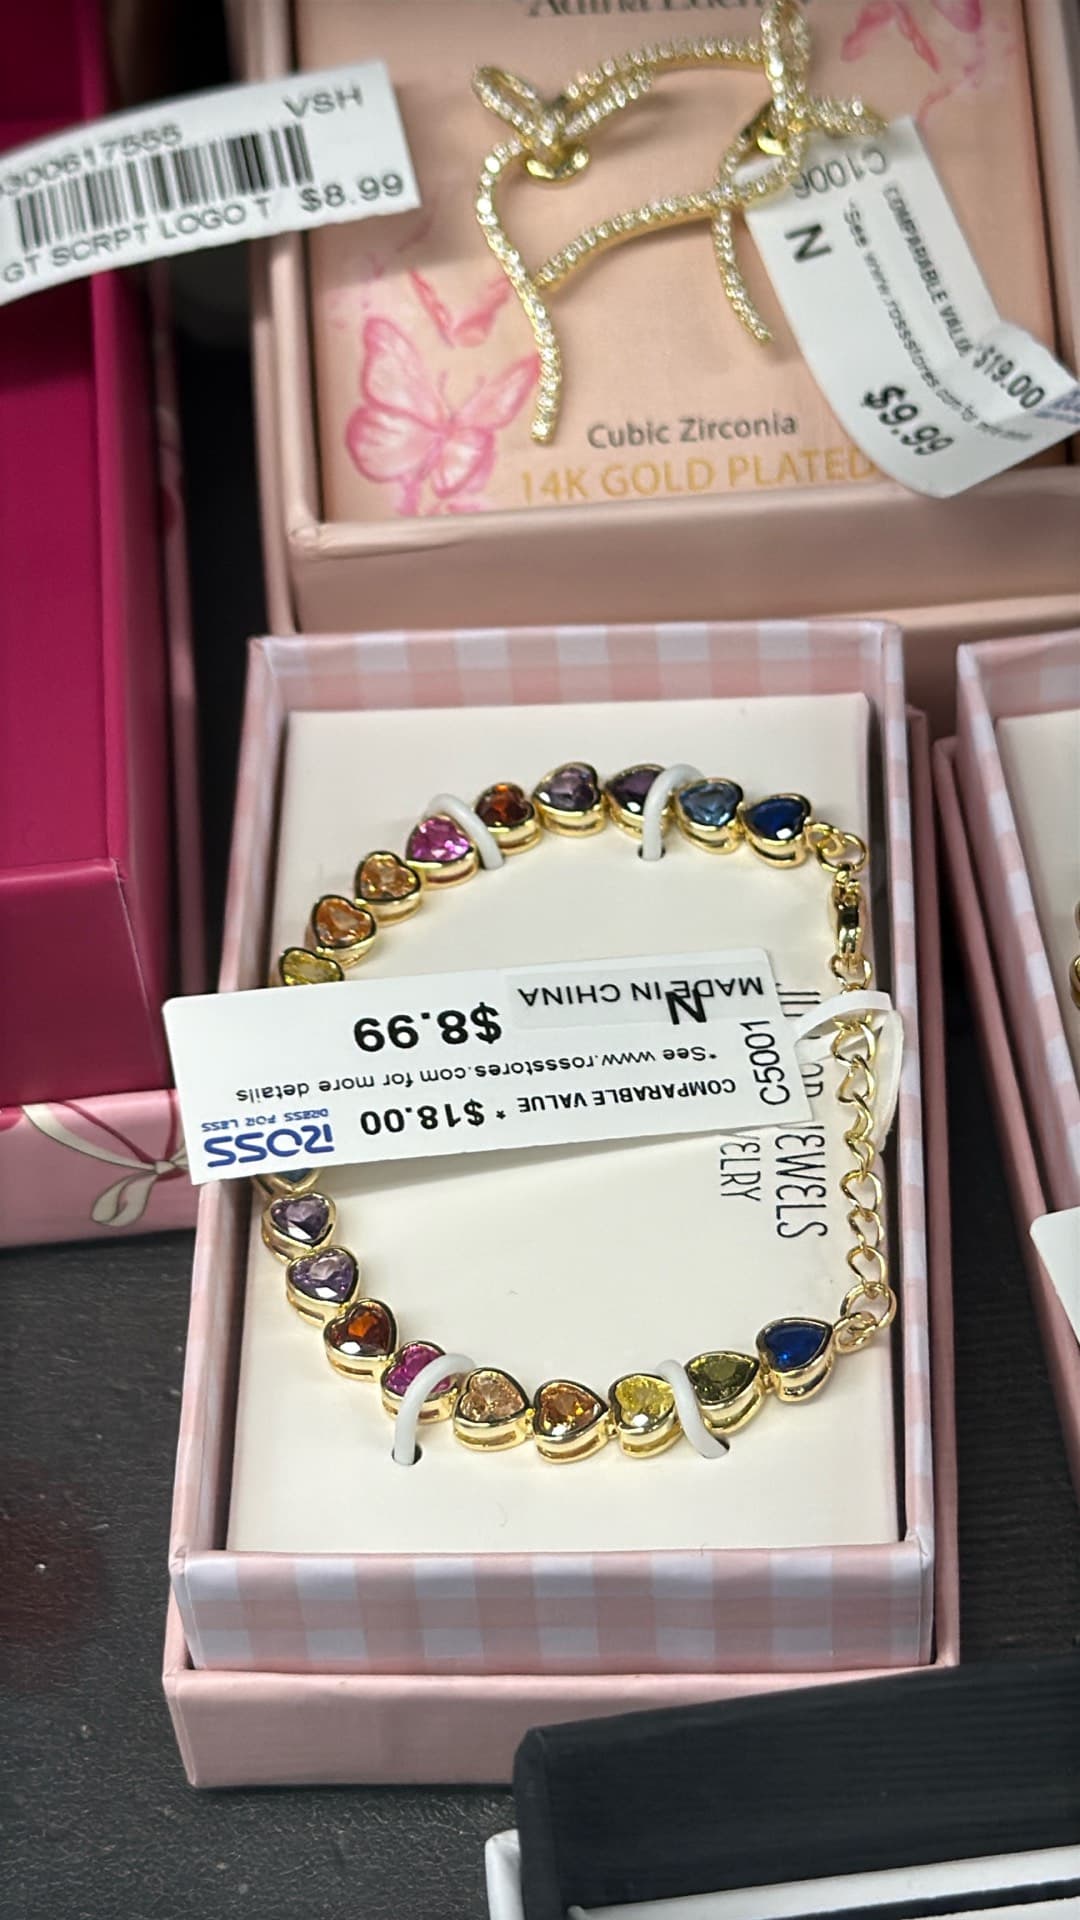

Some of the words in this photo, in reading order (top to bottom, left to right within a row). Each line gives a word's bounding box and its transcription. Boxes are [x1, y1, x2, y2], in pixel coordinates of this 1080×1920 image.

[282, 85, 364, 119] VSH
[300, 172, 404, 213] $8.99
[160, 203, 247, 240] LOGO
[256, 197, 273, 218] T
[784, 223, 833, 263] N
[972, 344, 1046, 409] $19.00
[586, 415, 671, 449] Cubic
[679, 409, 797, 443] Zirconia
[862, 384, 955, 456] $9.99
[520, 467, 590, 506] 14K
[600, 456, 717, 497] GOLD
[727, 447, 877, 488] PLATED
[518, 983, 621, 1008] CHINA
[631, 981, 663, 1001] IN
[669, 976, 765, 1001] MADE
[665, 988, 708, 1026] N
[353, 1001, 503, 1053] $8.99
[420, 1051, 656, 1084] www.rossstores.com
[739, 1020, 791, 1106] C5001
[236, 1082, 310, 1104] details
[318, 1076, 375, 1093] more
[383, 1072, 415, 1089] for
[592, 1078, 737, 1106] COMPARABLE
[245, 1113, 277, 1127] FOR
[284, 1108, 330, 1123] DRESS
[360, 1098, 486, 1136] $18.00
[517, 1092, 588, 1114] VALUE
[200, 1118, 239, 1133] LESS
[203, 1123, 335, 1168] ROSS
